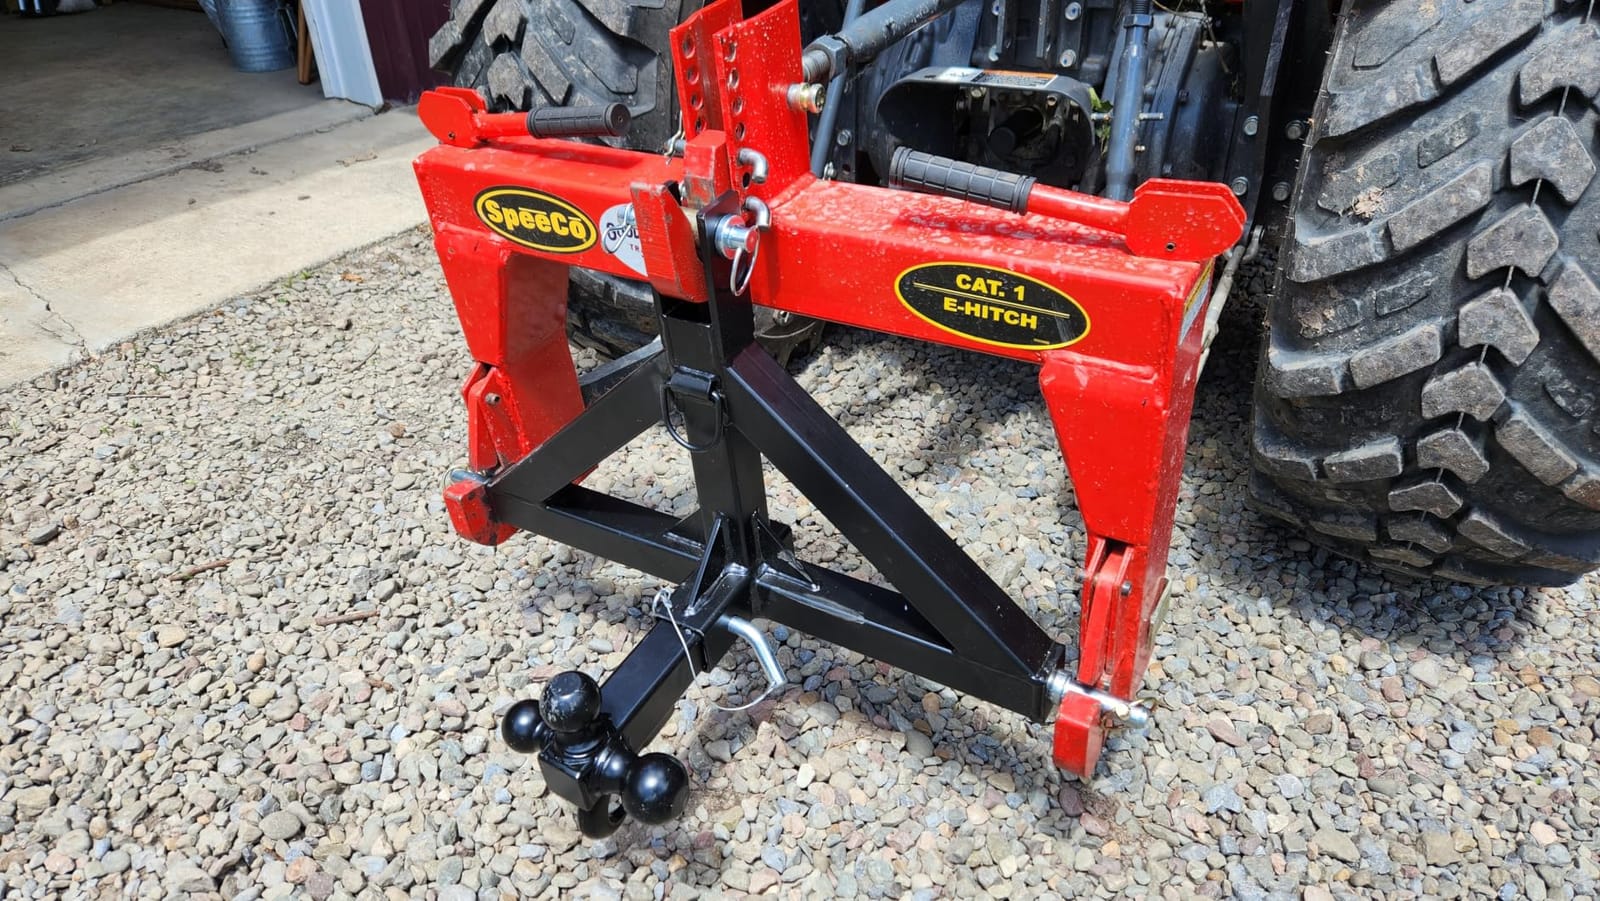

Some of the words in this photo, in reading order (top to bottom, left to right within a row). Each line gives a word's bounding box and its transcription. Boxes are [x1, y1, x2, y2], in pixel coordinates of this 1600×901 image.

[955, 273, 1005, 297] CAT.
[1013, 284, 1026, 302] 1
[943, 296, 1038, 330] E-HITCH
